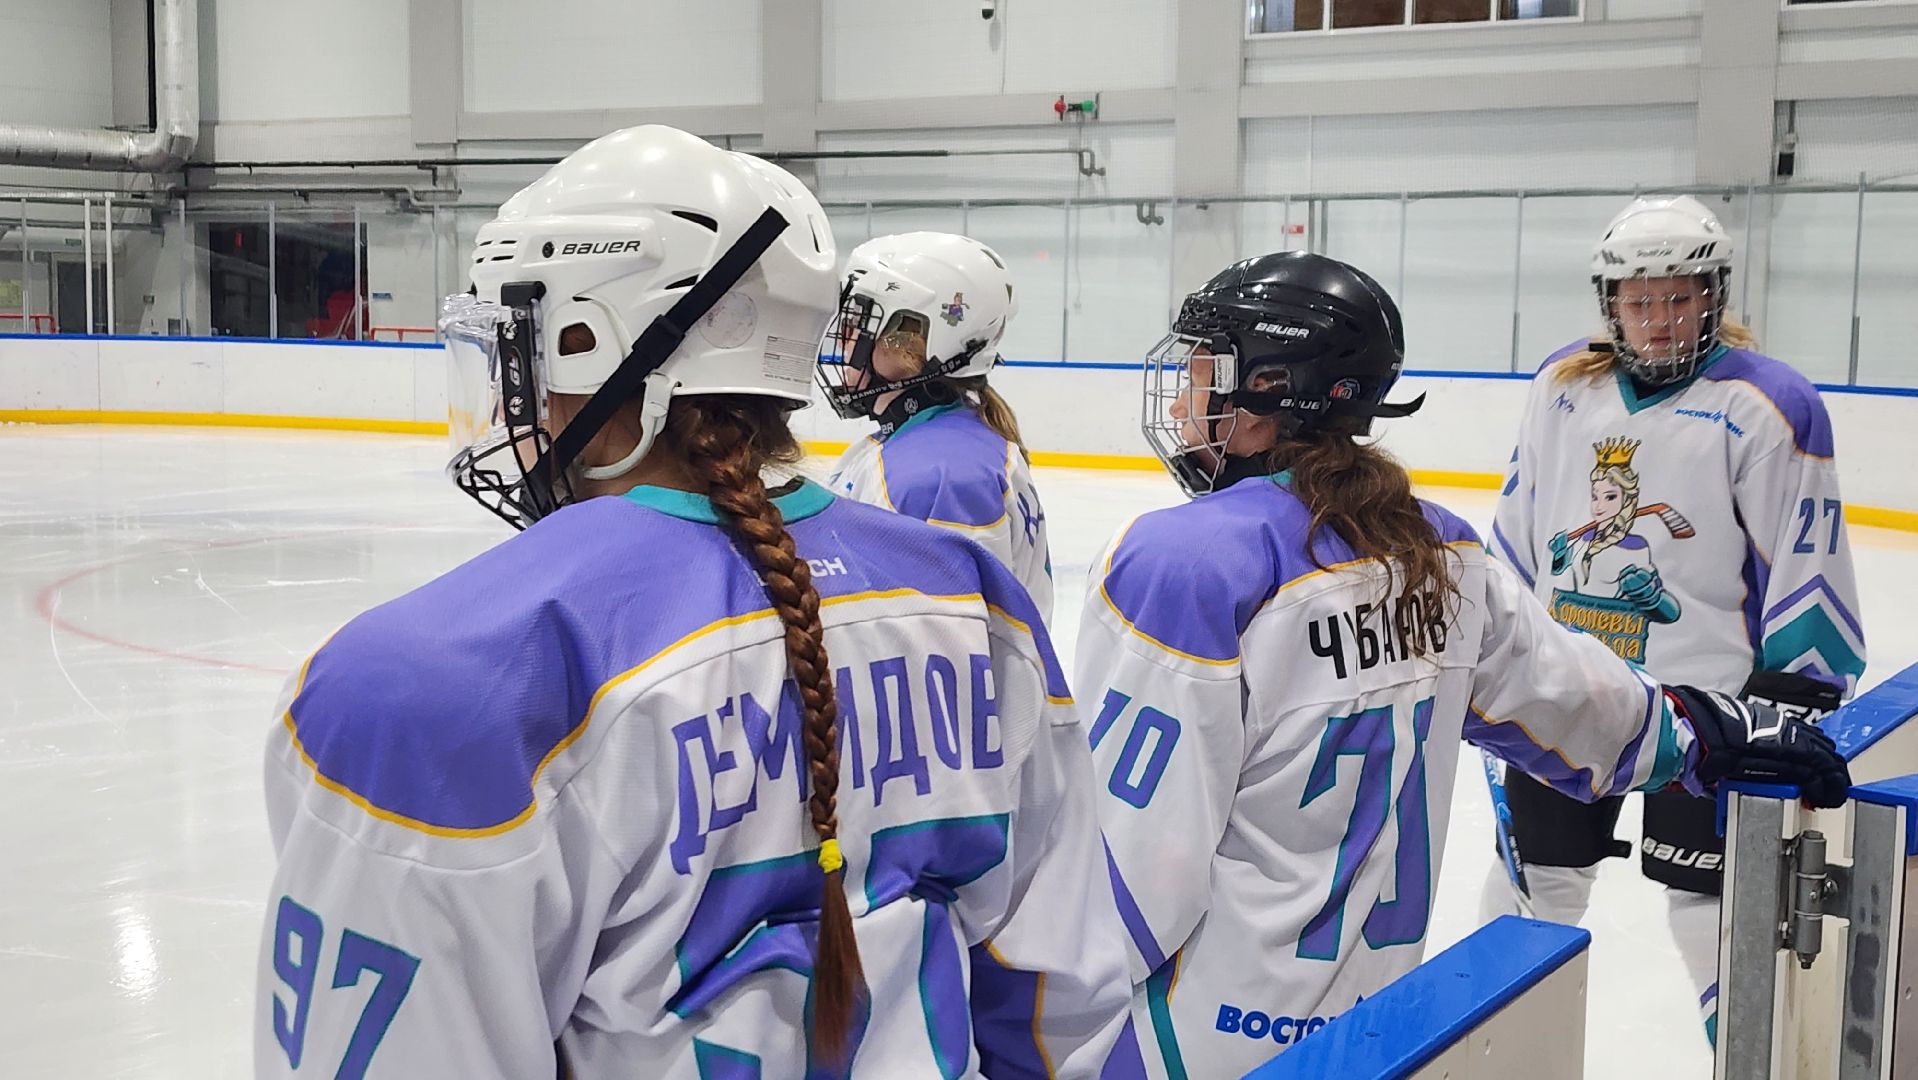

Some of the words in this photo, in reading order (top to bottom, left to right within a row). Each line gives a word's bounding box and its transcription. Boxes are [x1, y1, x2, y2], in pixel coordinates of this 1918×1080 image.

[561, 240, 641, 256] BAUER
[1254, 321, 1311, 339] BAUER
[1279, 398, 1332, 411] BUE
[1791, 497, 1842, 555] 27
[1641, 835, 1723, 872] BAUE
[272, 894, 423, 1080] 97
